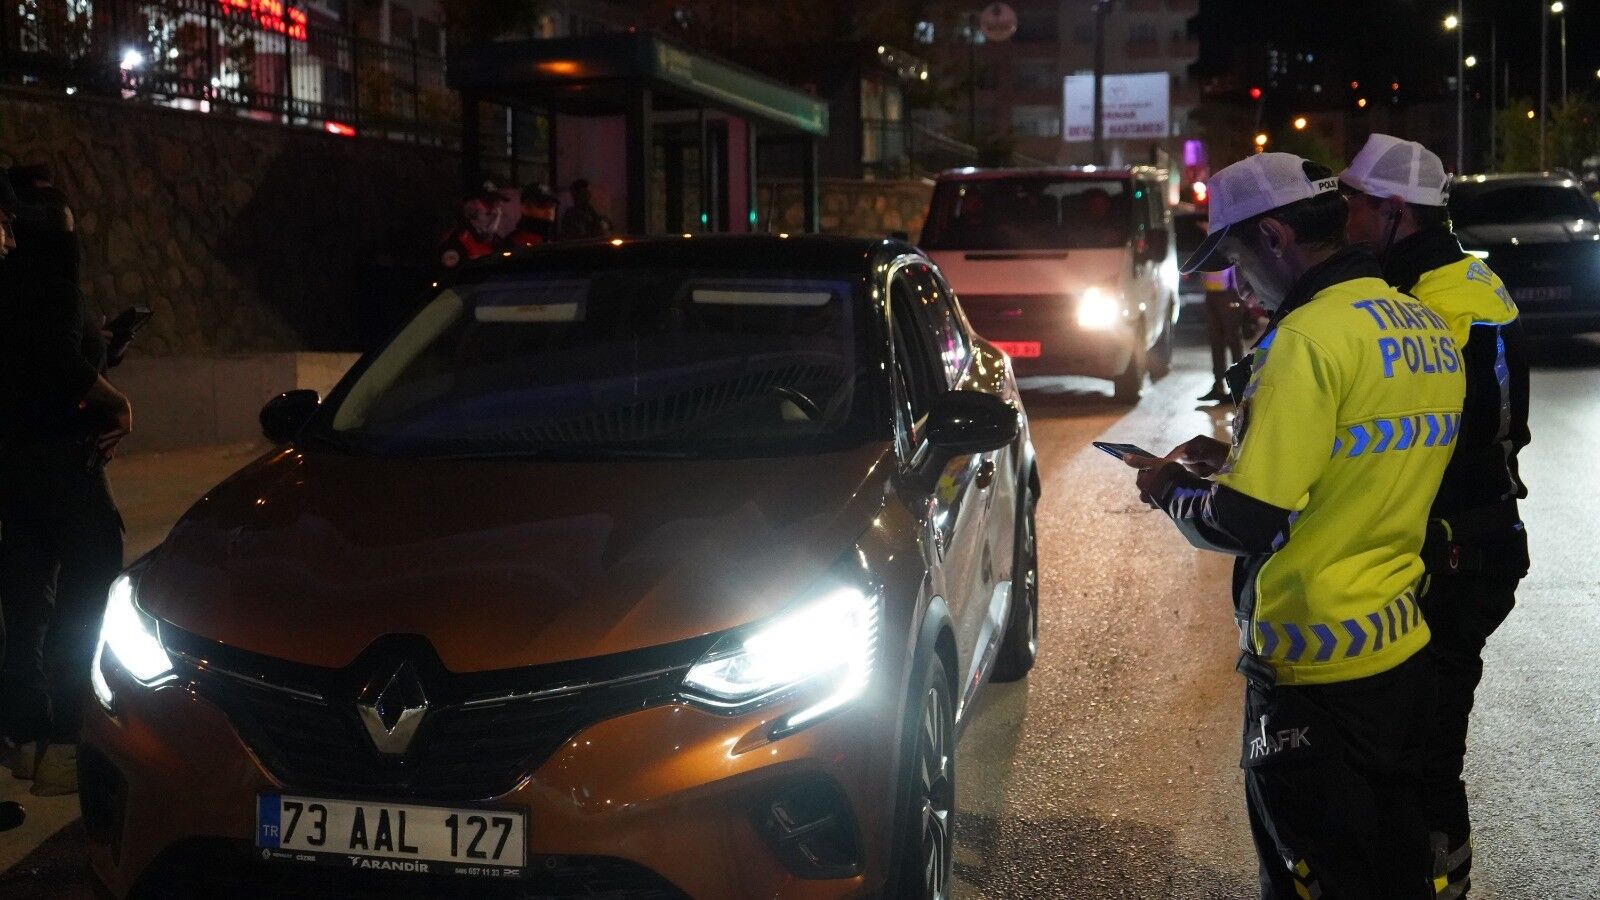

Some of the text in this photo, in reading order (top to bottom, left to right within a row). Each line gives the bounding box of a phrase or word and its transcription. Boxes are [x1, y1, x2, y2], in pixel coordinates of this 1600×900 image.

[262, 823, 279, 838] TR
[283, 802, 513, 860] 73 AAL 127
[348, 855, 430, 873] TARANDİR
